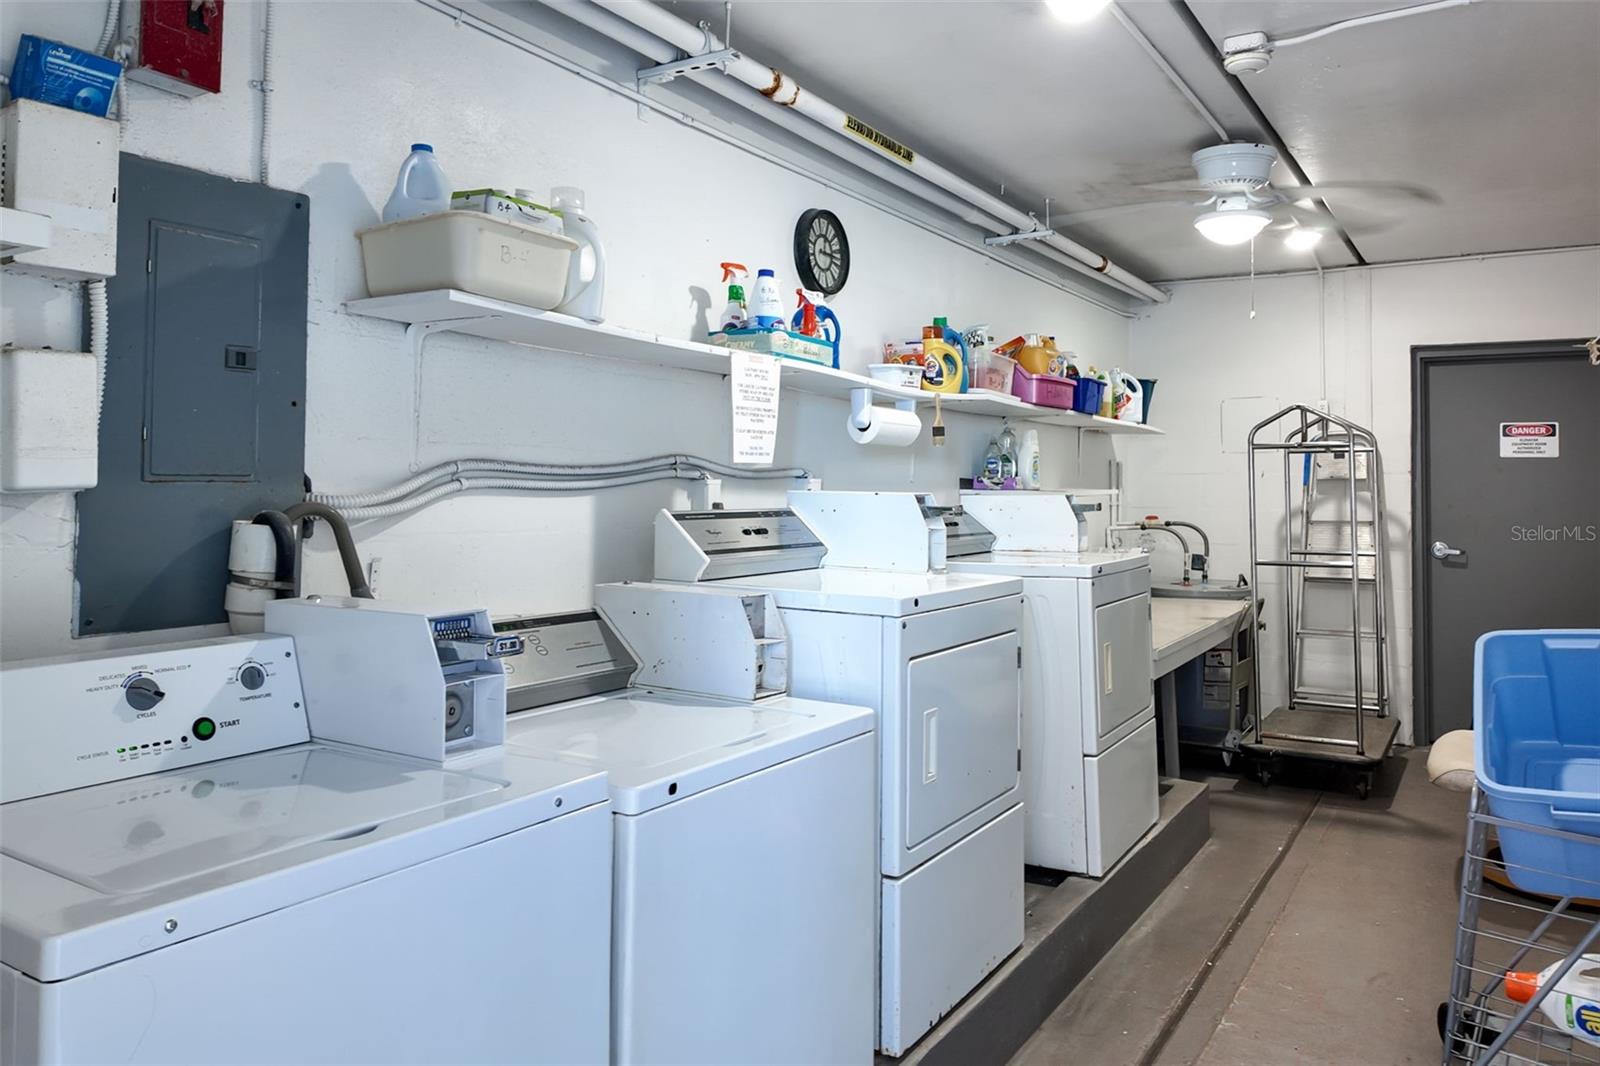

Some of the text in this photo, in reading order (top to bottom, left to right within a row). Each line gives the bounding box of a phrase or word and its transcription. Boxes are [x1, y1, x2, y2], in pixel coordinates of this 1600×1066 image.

[1511, 426, 1546, 435] DANGER
[136, 711, 157, 720] CYCLES
[219, 719, 241, 729] START
